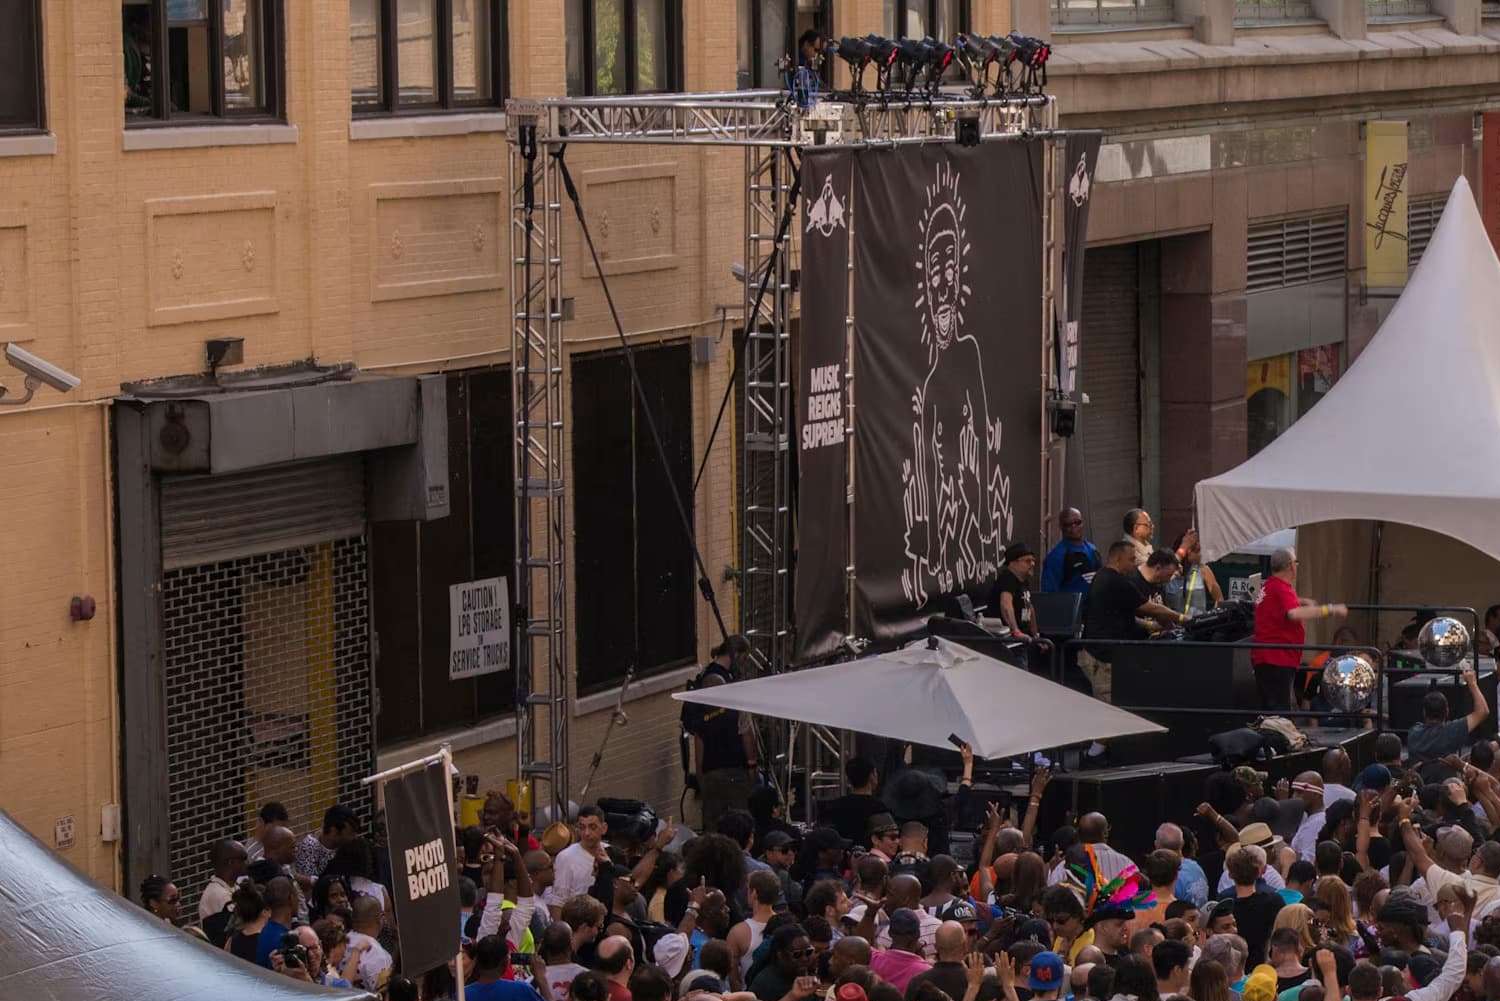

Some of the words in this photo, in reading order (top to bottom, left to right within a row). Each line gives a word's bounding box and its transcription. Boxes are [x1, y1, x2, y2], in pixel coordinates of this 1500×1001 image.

[811, 364, 840, 393] MUSIC
[808, 392, 841, 421] REIGNS
[802, 418, 845, 450] SUPREME
[462, 584, 498, 612] CAUTION!
[459, 613, 471, 637] LPG
[473, 607, 502, 634] STORAGE
[452, 646, 481, 673] SERVICE
[483, 641, 508, 667] TRUCKS
[405, 838, 445, 874] PHOTO
[408, 862, 450, 900] BOOTH
